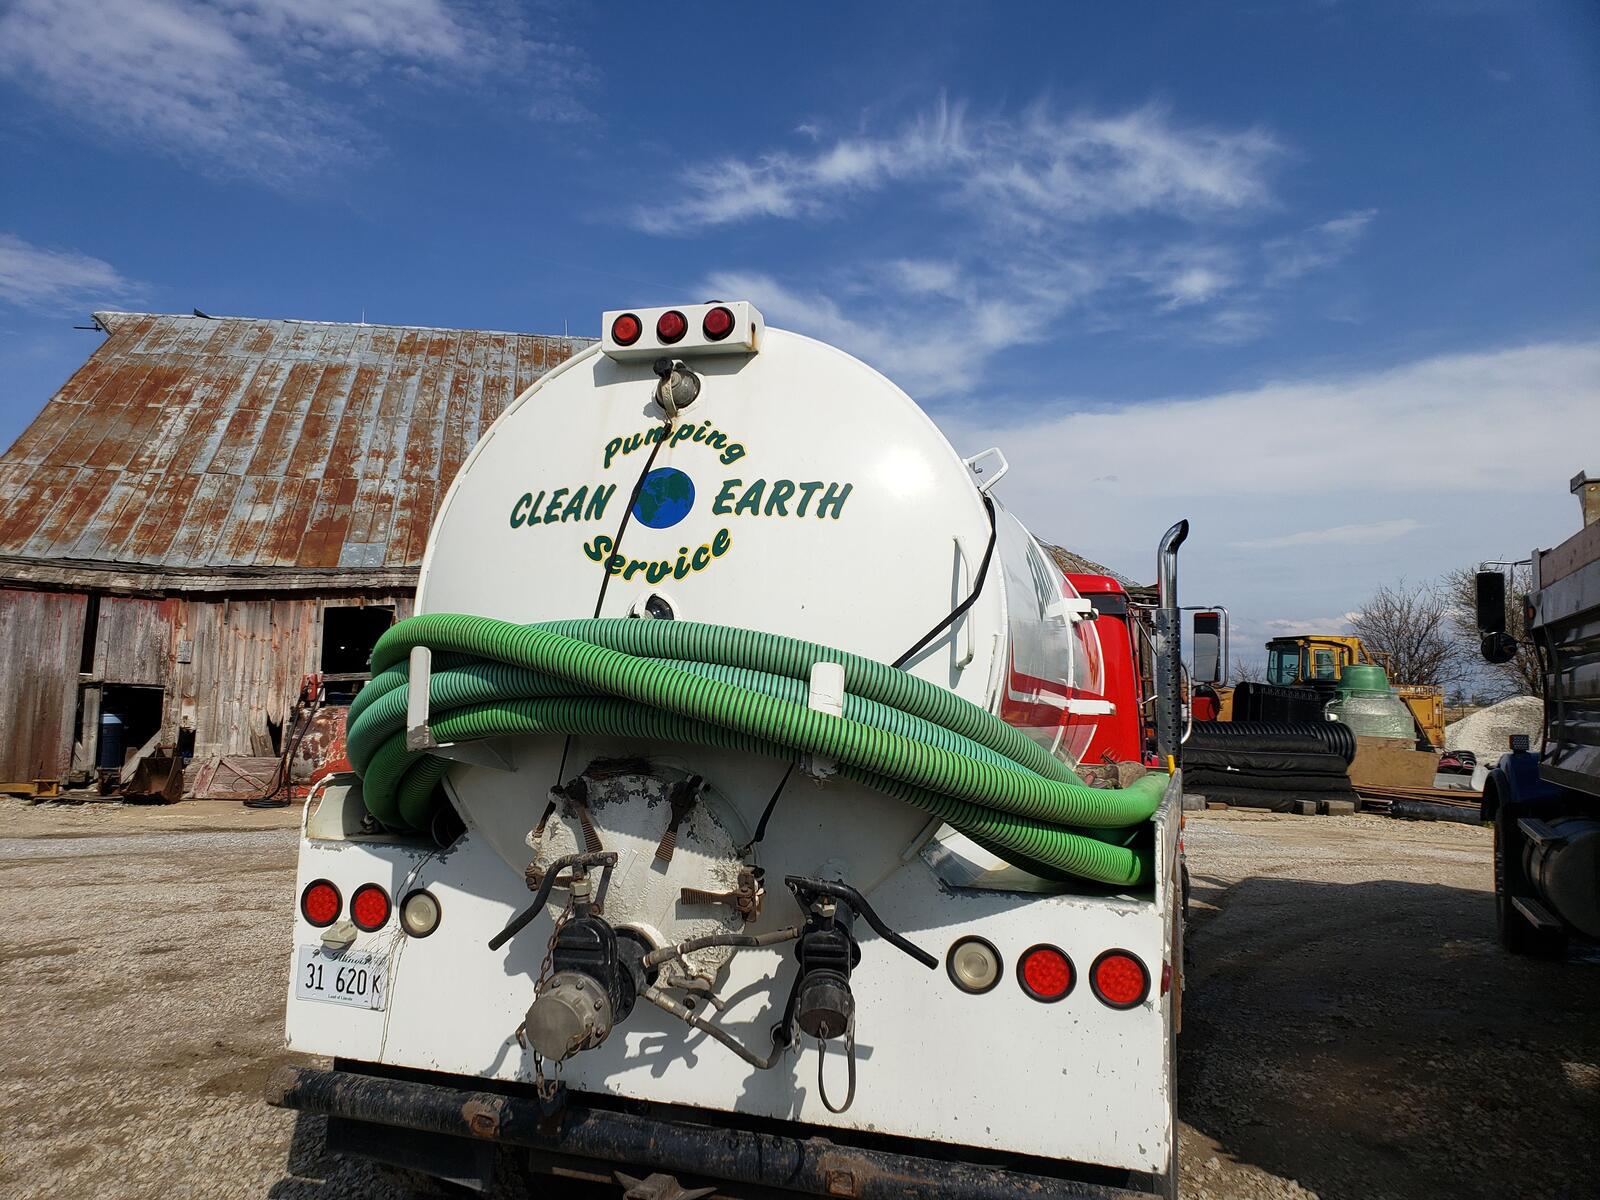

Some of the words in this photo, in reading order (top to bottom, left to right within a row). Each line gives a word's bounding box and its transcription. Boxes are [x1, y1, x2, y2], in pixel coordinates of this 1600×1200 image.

[509, 484, 617, 529] CLEAN
[711, 478, 854, 519] EARTH
[583, 528, 731, 584] Service
[305, 963, 324, 990] 31
[335, 966, 368, 995] 620
[372, 974, 381, 994] K
